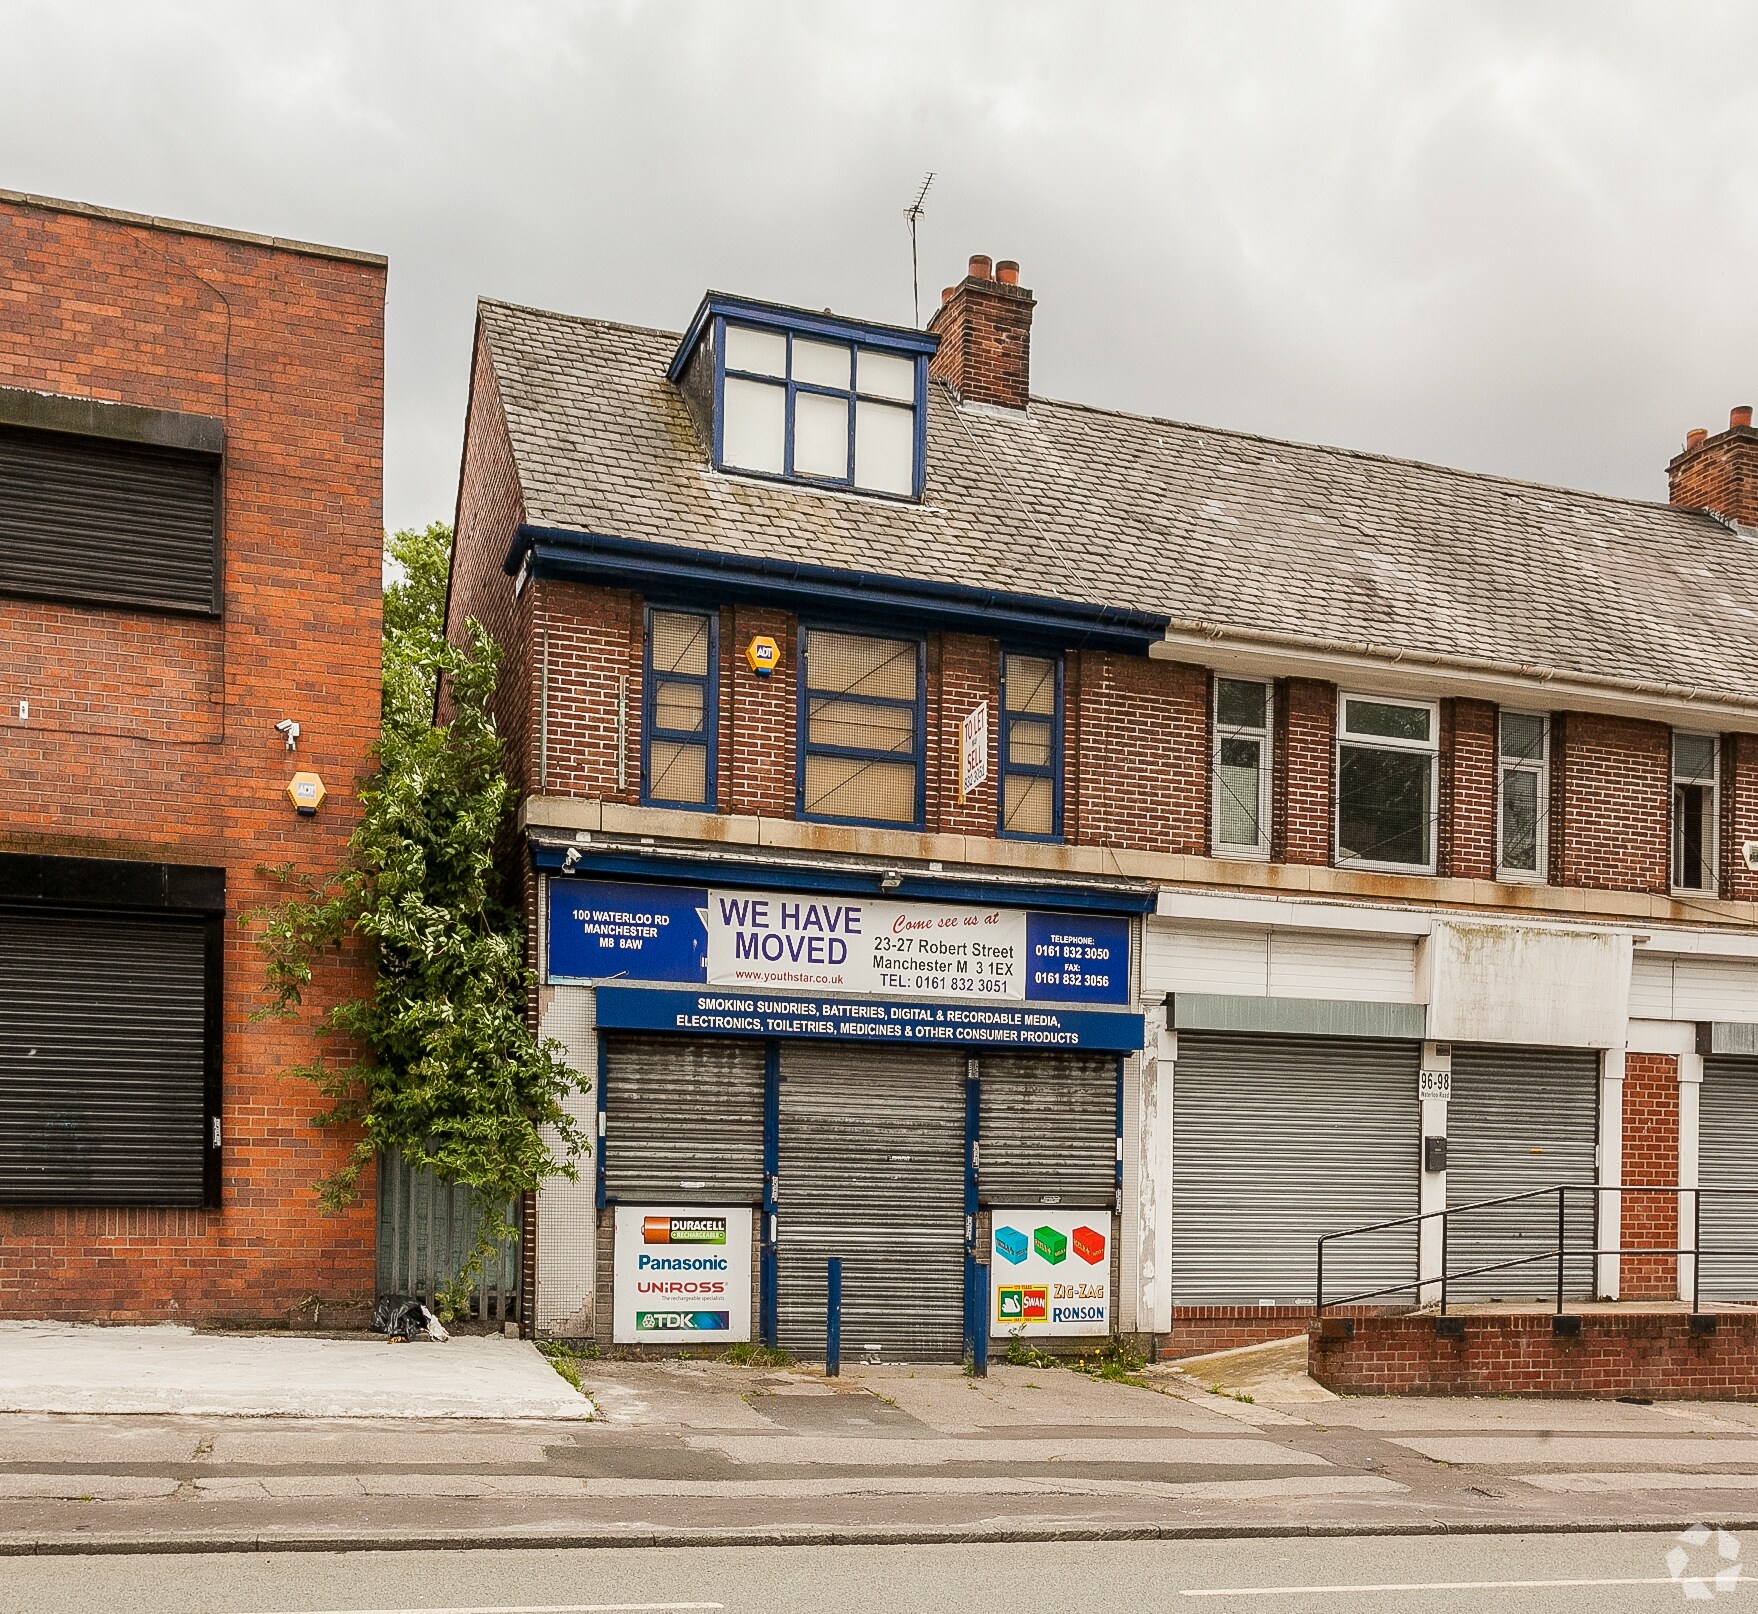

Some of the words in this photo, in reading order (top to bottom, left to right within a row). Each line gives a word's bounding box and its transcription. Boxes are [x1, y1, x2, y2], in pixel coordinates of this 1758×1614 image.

[757, 646, 772, 658] ADT
[965, 720, 972, 743] TO
[974, 708, 985, 735] LET
[967, 745, 983, 773] SELL
[572, 909, 591, 921] 100
[592, 910, 652, 924] WATERLOO
[654, 914, 670, 925] RD
[719, 898, 769, 928] WE
[781, 902, 862, 934] HAVE
[892, 914, 933, 934] Come
[937, 917, 958, 928] see
[963, 915, 979, 926] us
[983, 911, 1000, 925] at
[584, 922, 658, 938] MANCHESTER
[599, 936, 615, 948] M8
[619, 938, 643, 949] 8AW
[874, 936, 914, 953] 23-27
[918, 938, 968, 956] Robert
[971, 942, 1014, 959] Street
[1050, 934, 1095, 945] TELEPHONE:
[735, 931, 848, 965] MOVED
[1035, 944, 1060, 957] 0161
[1063, 946, 1083, 959] 832
[1084, 947, 1110, 960] 3050
[872, 954, 953, 973] Manchester
[956, 960, 968, 974] M
[976, 961, 984, 975] 3
[988, 962, 1014, 976] 1EX
[1064, 963, 1081, 972] FAX:
[735, 970, 844, 985] www.youthstar.co.uk
[880, 973, 911, 988] TEL:
[915, 975, 946, 990] 0161
[950, 977, 974, 991] 832
[978, 979, 1007, 993] 3051
[1035, 971, 1060, 985] 0161
[1062, 973, 1082, 986] 832
[1084, 974, 1109, 987] 3056
[697, 997, 754, 1012] SMOKING
[756, 1000, 820, 1016] SUNDRIES,
[822, 1004, 888, 1020] BATTERIES,
[890, 1008, 934, 1021] DIGITAL
[936, 1010, 945, 1021] &
[947, 1010, 1022, 1025] RECORDABLE
[1024, 1014, 1061, 1028] MEDIA,
[676, 1014, 764, 1031] ELECTRONICS,
[766, 1018, 837, 1035] TOILETRIES,
[840, 1022, 902, 1037] MEDICINES
[904, 1025, 913, 1037] &
[915, 1026, 954, 1038] OTHER
[956, 1027, 1018, 1042] CONSUMER
[1020, 1032, 1079, 1044] PRODUCTS
[1421, 1072, 1450, 1090] 96-98
[1439, 1091, 1450, 1099] Road
[671, 1220, 724, 1231] DURACELL
[676, 1231, 718, 1239] RECHARGEABLE
[638, 1254, 728, 1271] Panasonic
[1053, 1283, 1104, 1299] ZIG-ZAG
[1023, 1296, 1046, 1309] SWAN
[1053, 1306, 1105, 1322] RONSON
